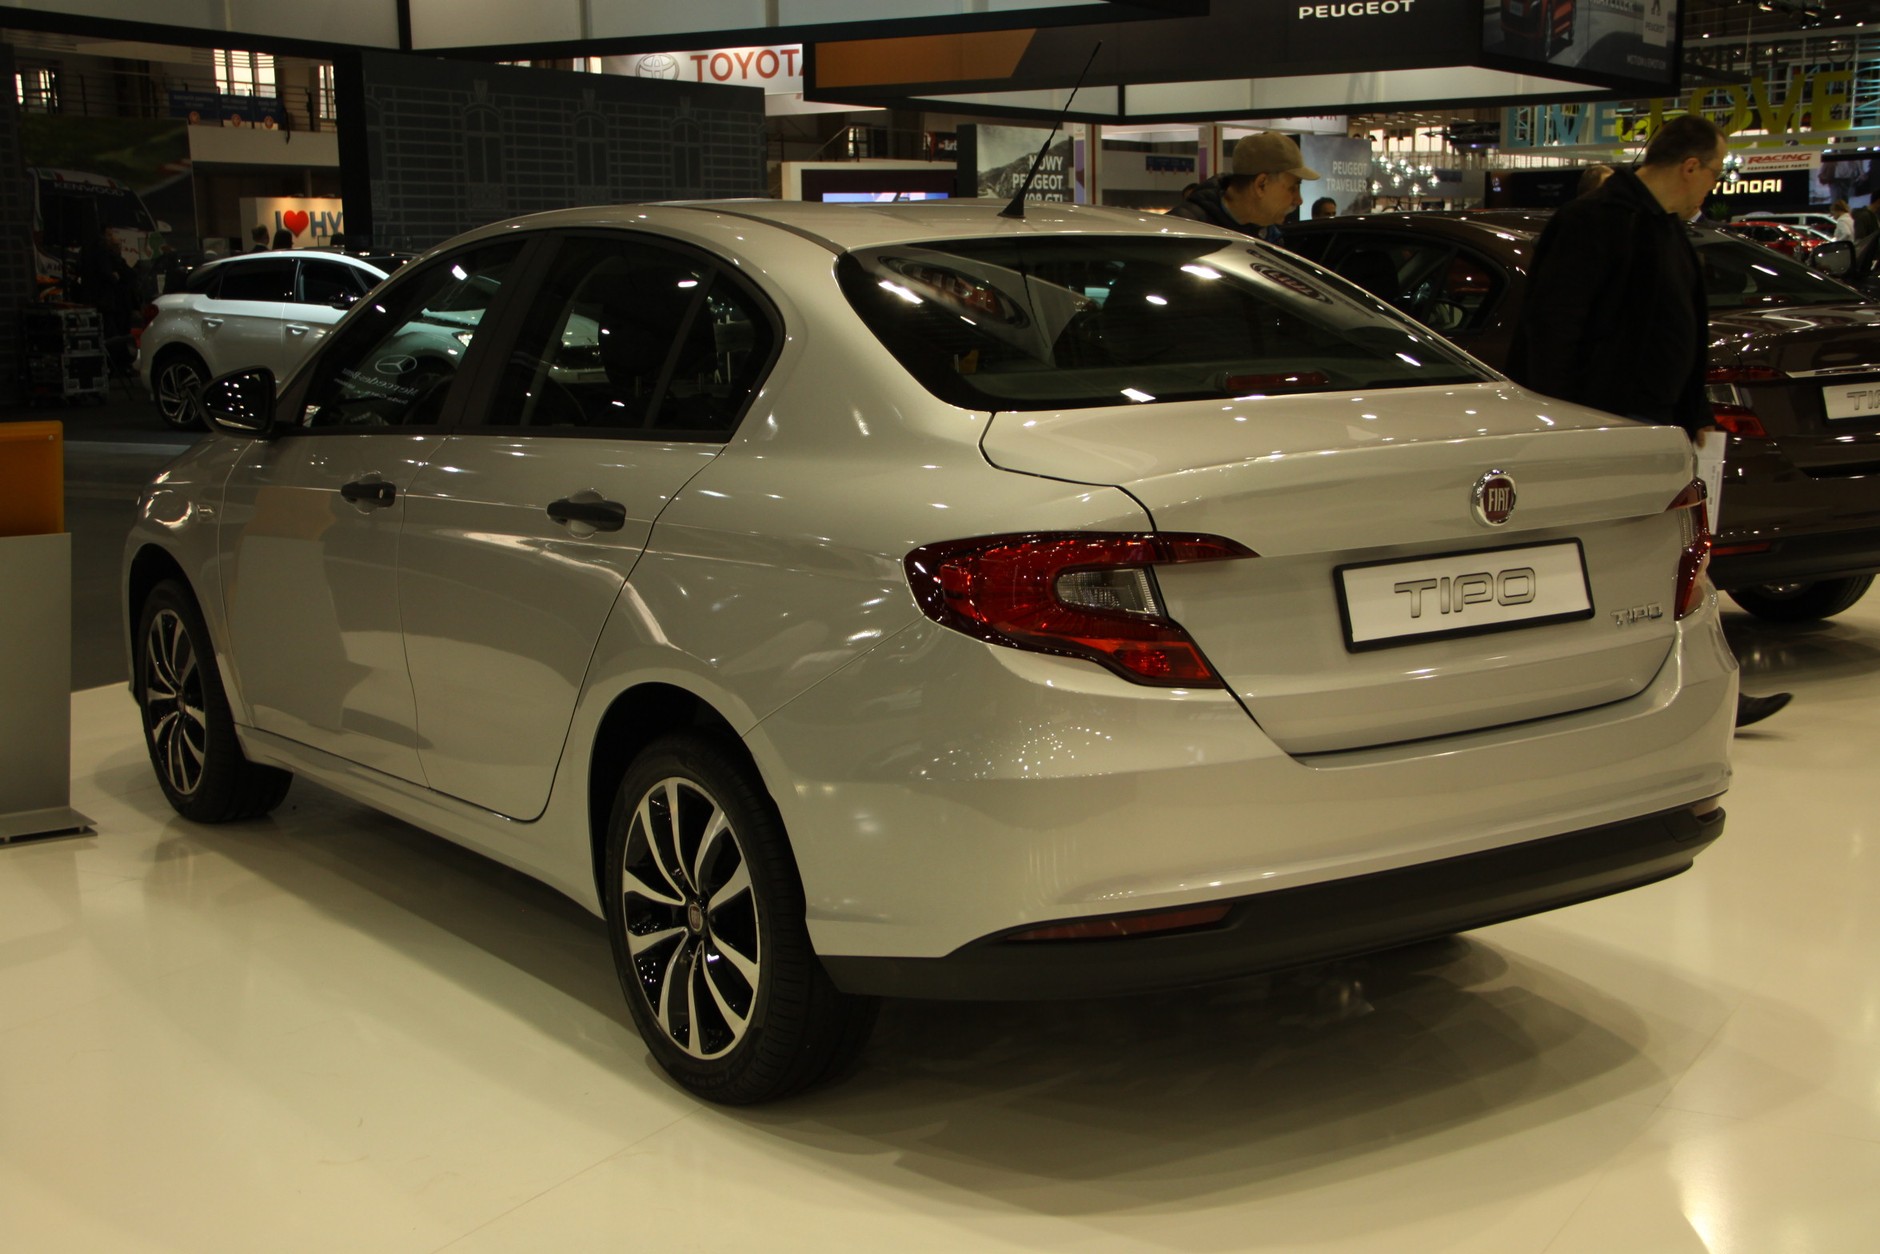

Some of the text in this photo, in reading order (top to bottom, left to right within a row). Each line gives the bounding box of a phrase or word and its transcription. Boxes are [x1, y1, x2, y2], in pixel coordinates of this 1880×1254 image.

[1298, 0, 1415, 20] PEUGEOT
[690, 48, 804, 82] TOYOT
[1507, 101, 1620, 147] LIVE
[1029, 155, 1063, 171] NOWY
[1332, 161, 1368, 176] PEUGEOT
[1747, 153, 1812, 164] RACING
[1326, 178, 1368, 192] TRAVELLER
[1847, 390, 1880, 411] TI
[1488, 487, 1510, 512] FIAT
[1394, 566, 1536, 619] TIPO
[1610, 602, 1664, 628] TIPO
